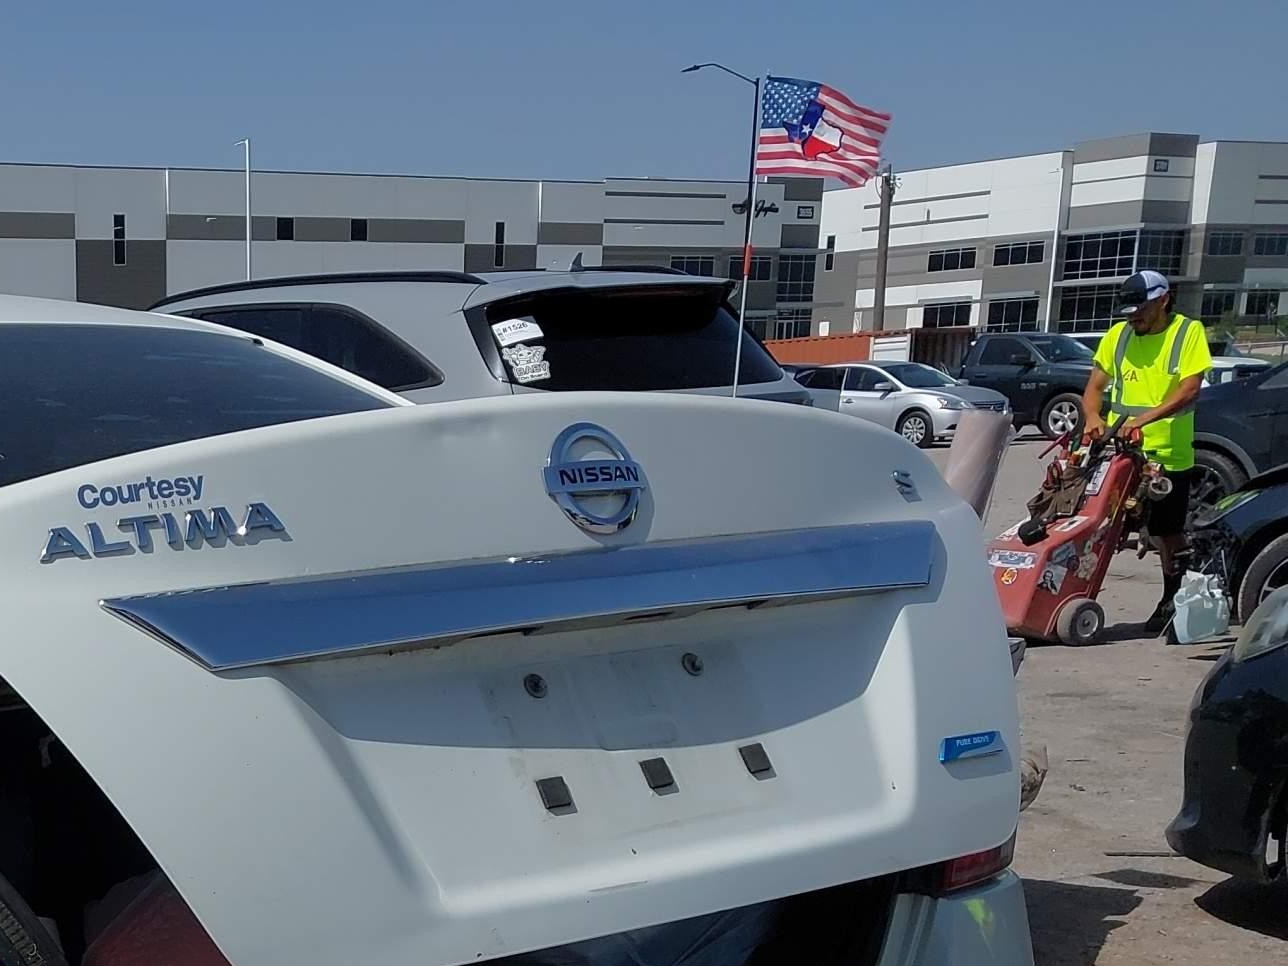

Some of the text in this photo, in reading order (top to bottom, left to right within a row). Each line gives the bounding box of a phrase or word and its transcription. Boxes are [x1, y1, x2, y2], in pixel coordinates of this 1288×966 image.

[558, 466, 639, 486] NISSAN
[77, 475, 203, 509] Courtesy
[147, 499, 194, 511] NISSAN
[40, 502, 287, 564] ALTIMA
